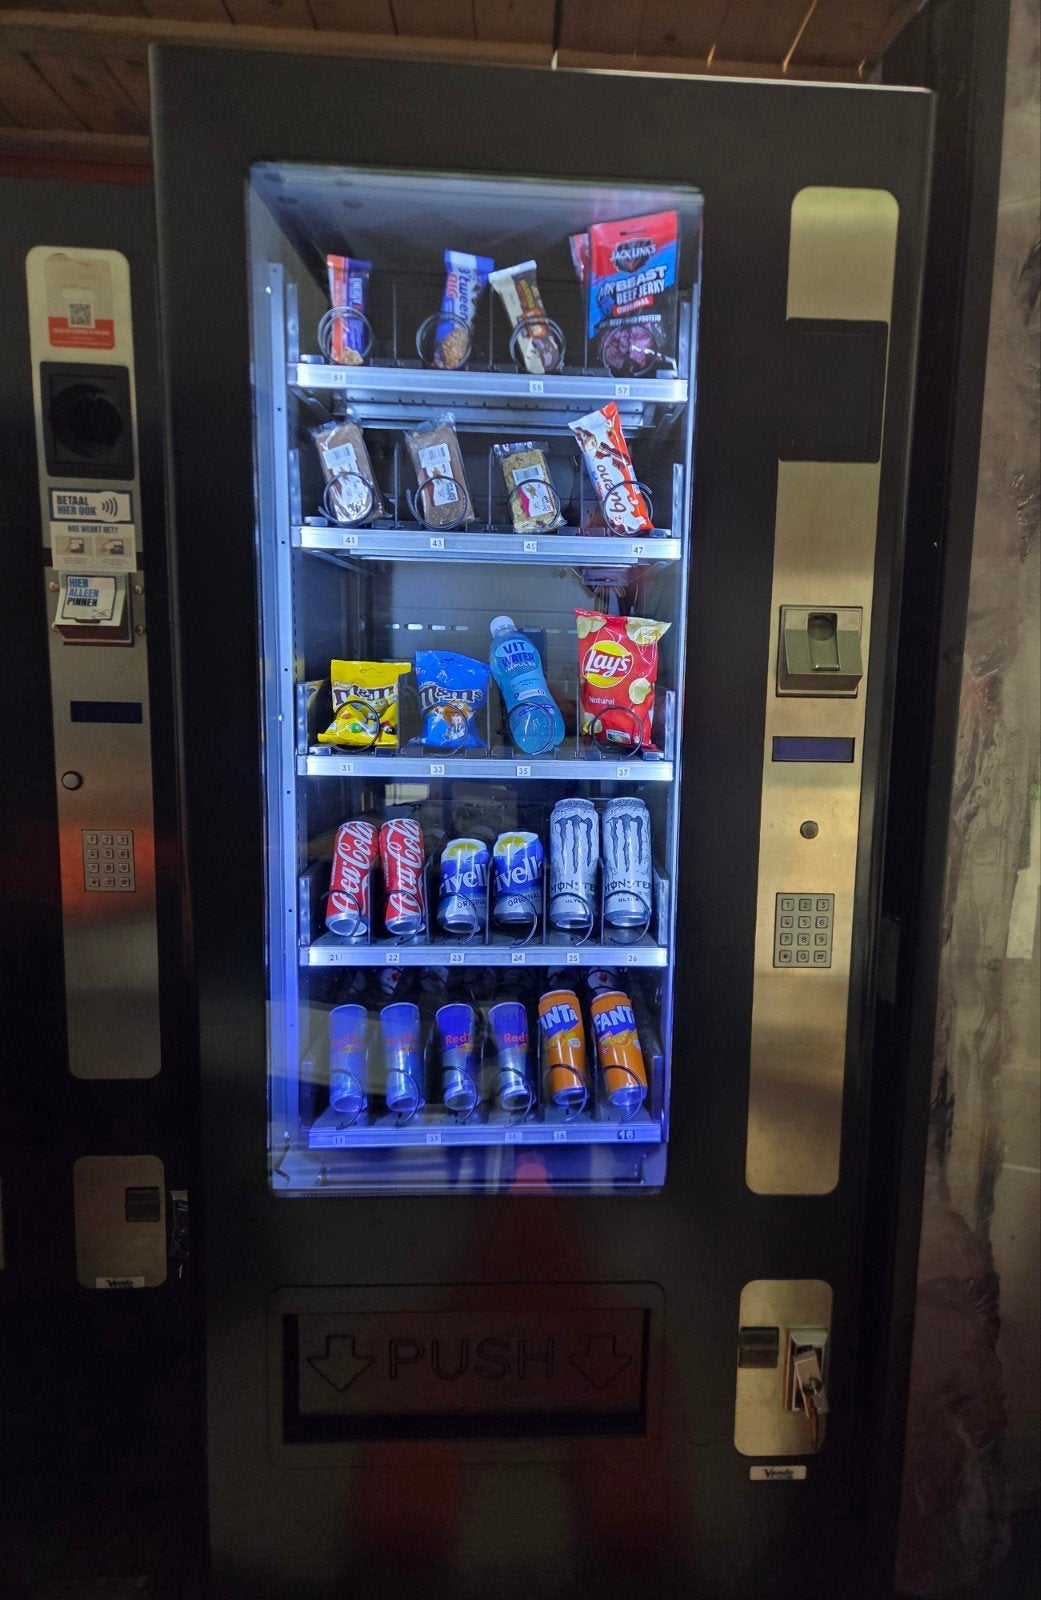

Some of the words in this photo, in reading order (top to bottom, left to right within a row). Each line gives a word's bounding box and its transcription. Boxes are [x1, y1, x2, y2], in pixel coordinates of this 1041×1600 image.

[610, 248, 632, 263] JACK
[638, 278, 666, 297] JERKY
[617, 387, 628, 395] 57
[596, 464, 626, 513] bueno
[57, 495, 89, 506] BETAAL
[57, 505, 77, 516] HIER
[79, 506, 97, 516] OOK
[69, 578, 89, 588] HIER
[68, 588, 99, 597] ALLEEN
[67, 597, 98, 607] PINNEN
[503, 641, 526, 655] VIT
[501, 653, 536, 668] WATER
[584, 650, 631, 678] Lay's
[588, 695, 615, 705] Naturel
[341, 764, 351, 772] 31
[518, 767, 528, 775] 35
[446, 1033, 467, 1044] Red
[504, 1032, 525, 1042] Red
[618, 1130, 634, 1139] 16
[335, 1137, 343, 1145] 11
[389, 1337, 555, 1380] PUSH
